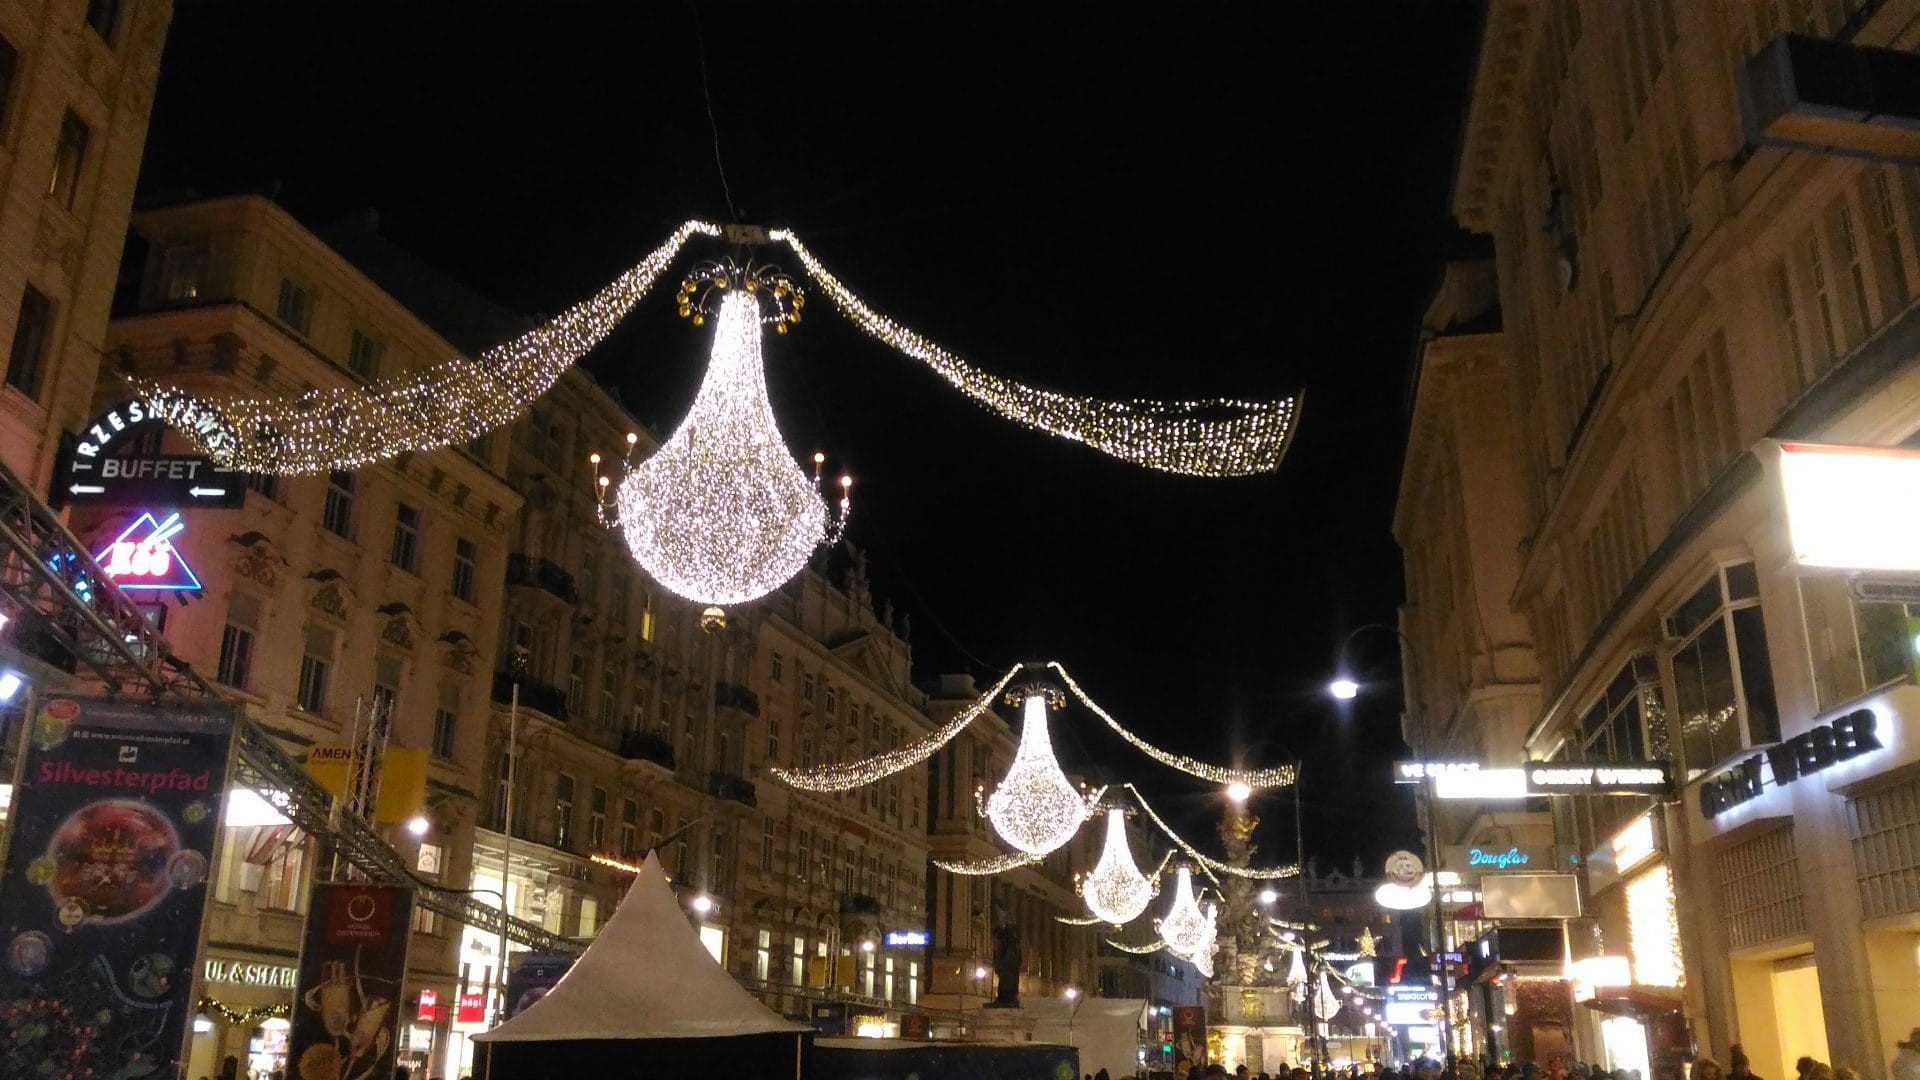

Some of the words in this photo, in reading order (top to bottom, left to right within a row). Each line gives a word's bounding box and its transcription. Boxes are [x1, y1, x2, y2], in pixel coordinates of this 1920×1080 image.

[102, 459, 201, 479] BUFFET
[1700, 753, 1764, 820] GERRY
[1766, 708, 1884, 787] WEBER
[39, 761, 210, 793] Silvesterpfad
[1595, 769, 1666, 784] WEBER
[1470, 847, 1529, 869] Douglas
[230, 963, 244, 983] &
